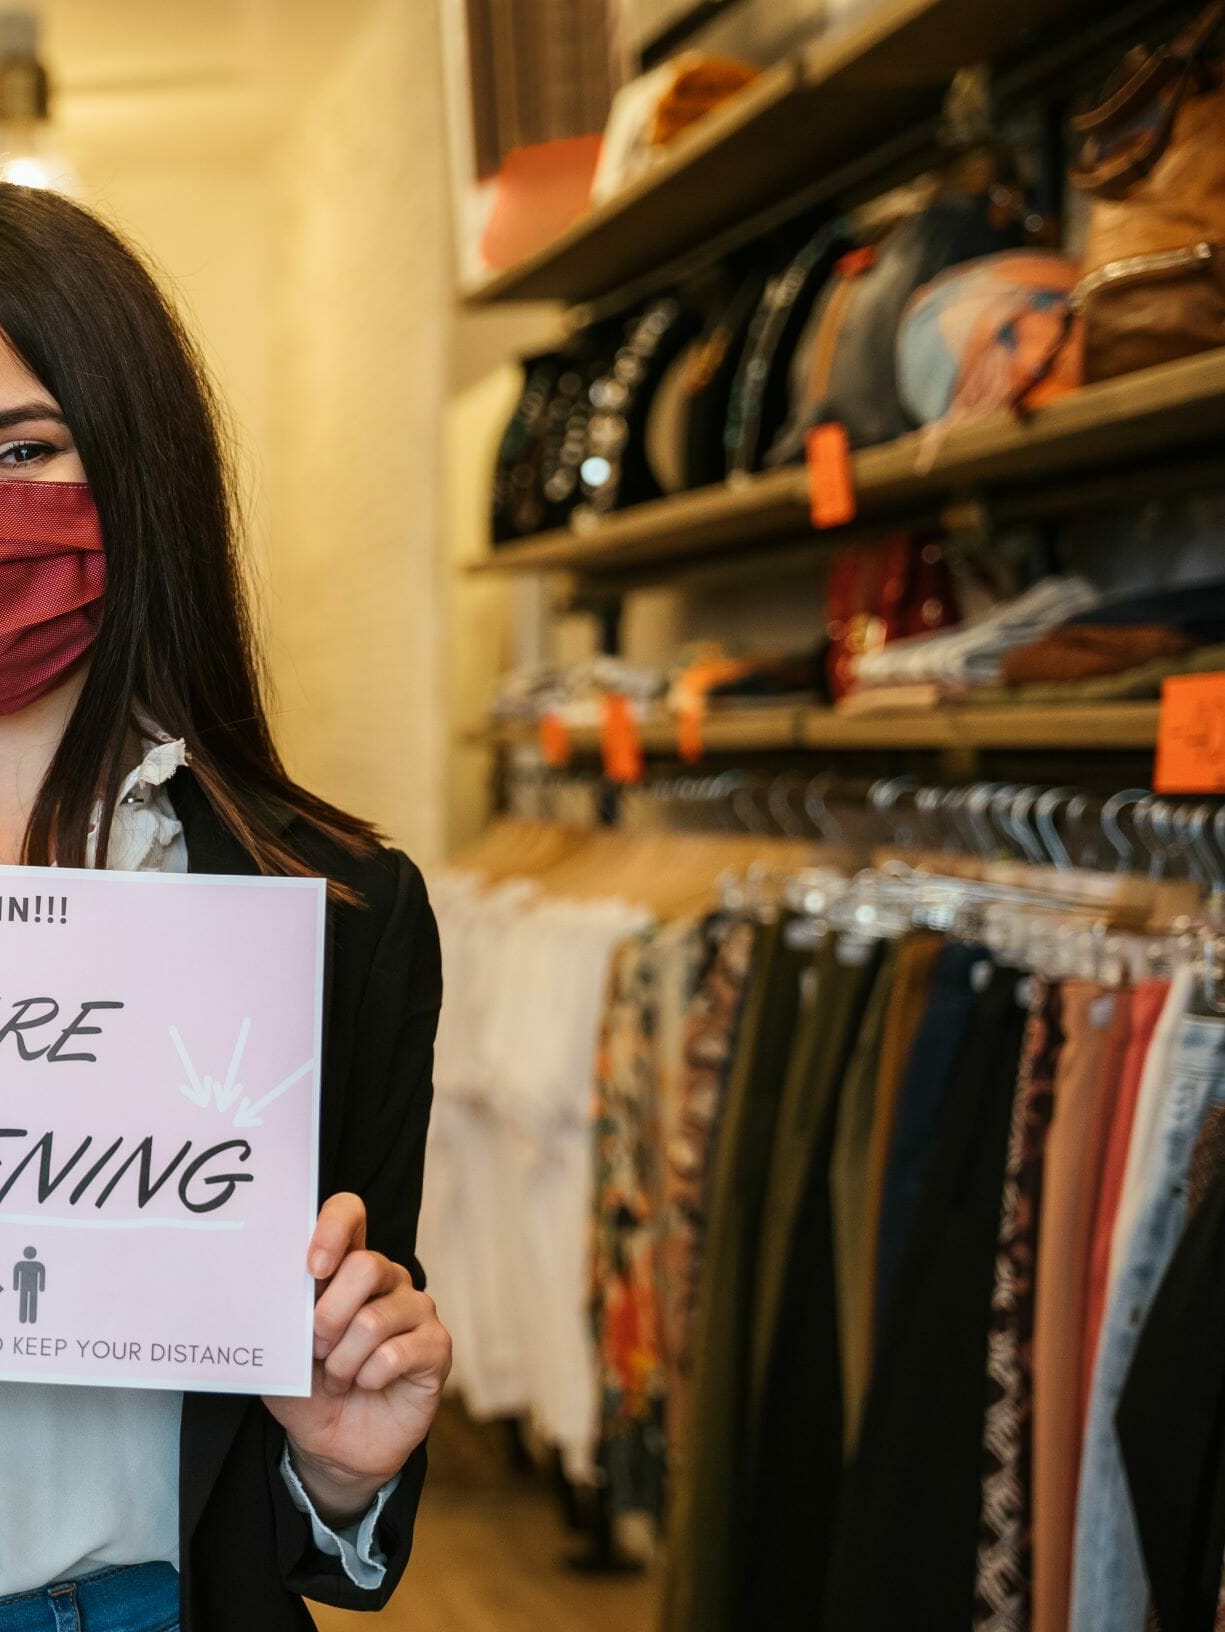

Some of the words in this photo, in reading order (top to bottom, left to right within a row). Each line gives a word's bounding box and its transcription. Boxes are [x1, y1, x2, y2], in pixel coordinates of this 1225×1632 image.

[13, 1336, 67, 1356] KEEP
[76, 1340, 142, 1361] YOUR
[151, 1343, 264, 1367] DISTANCE
